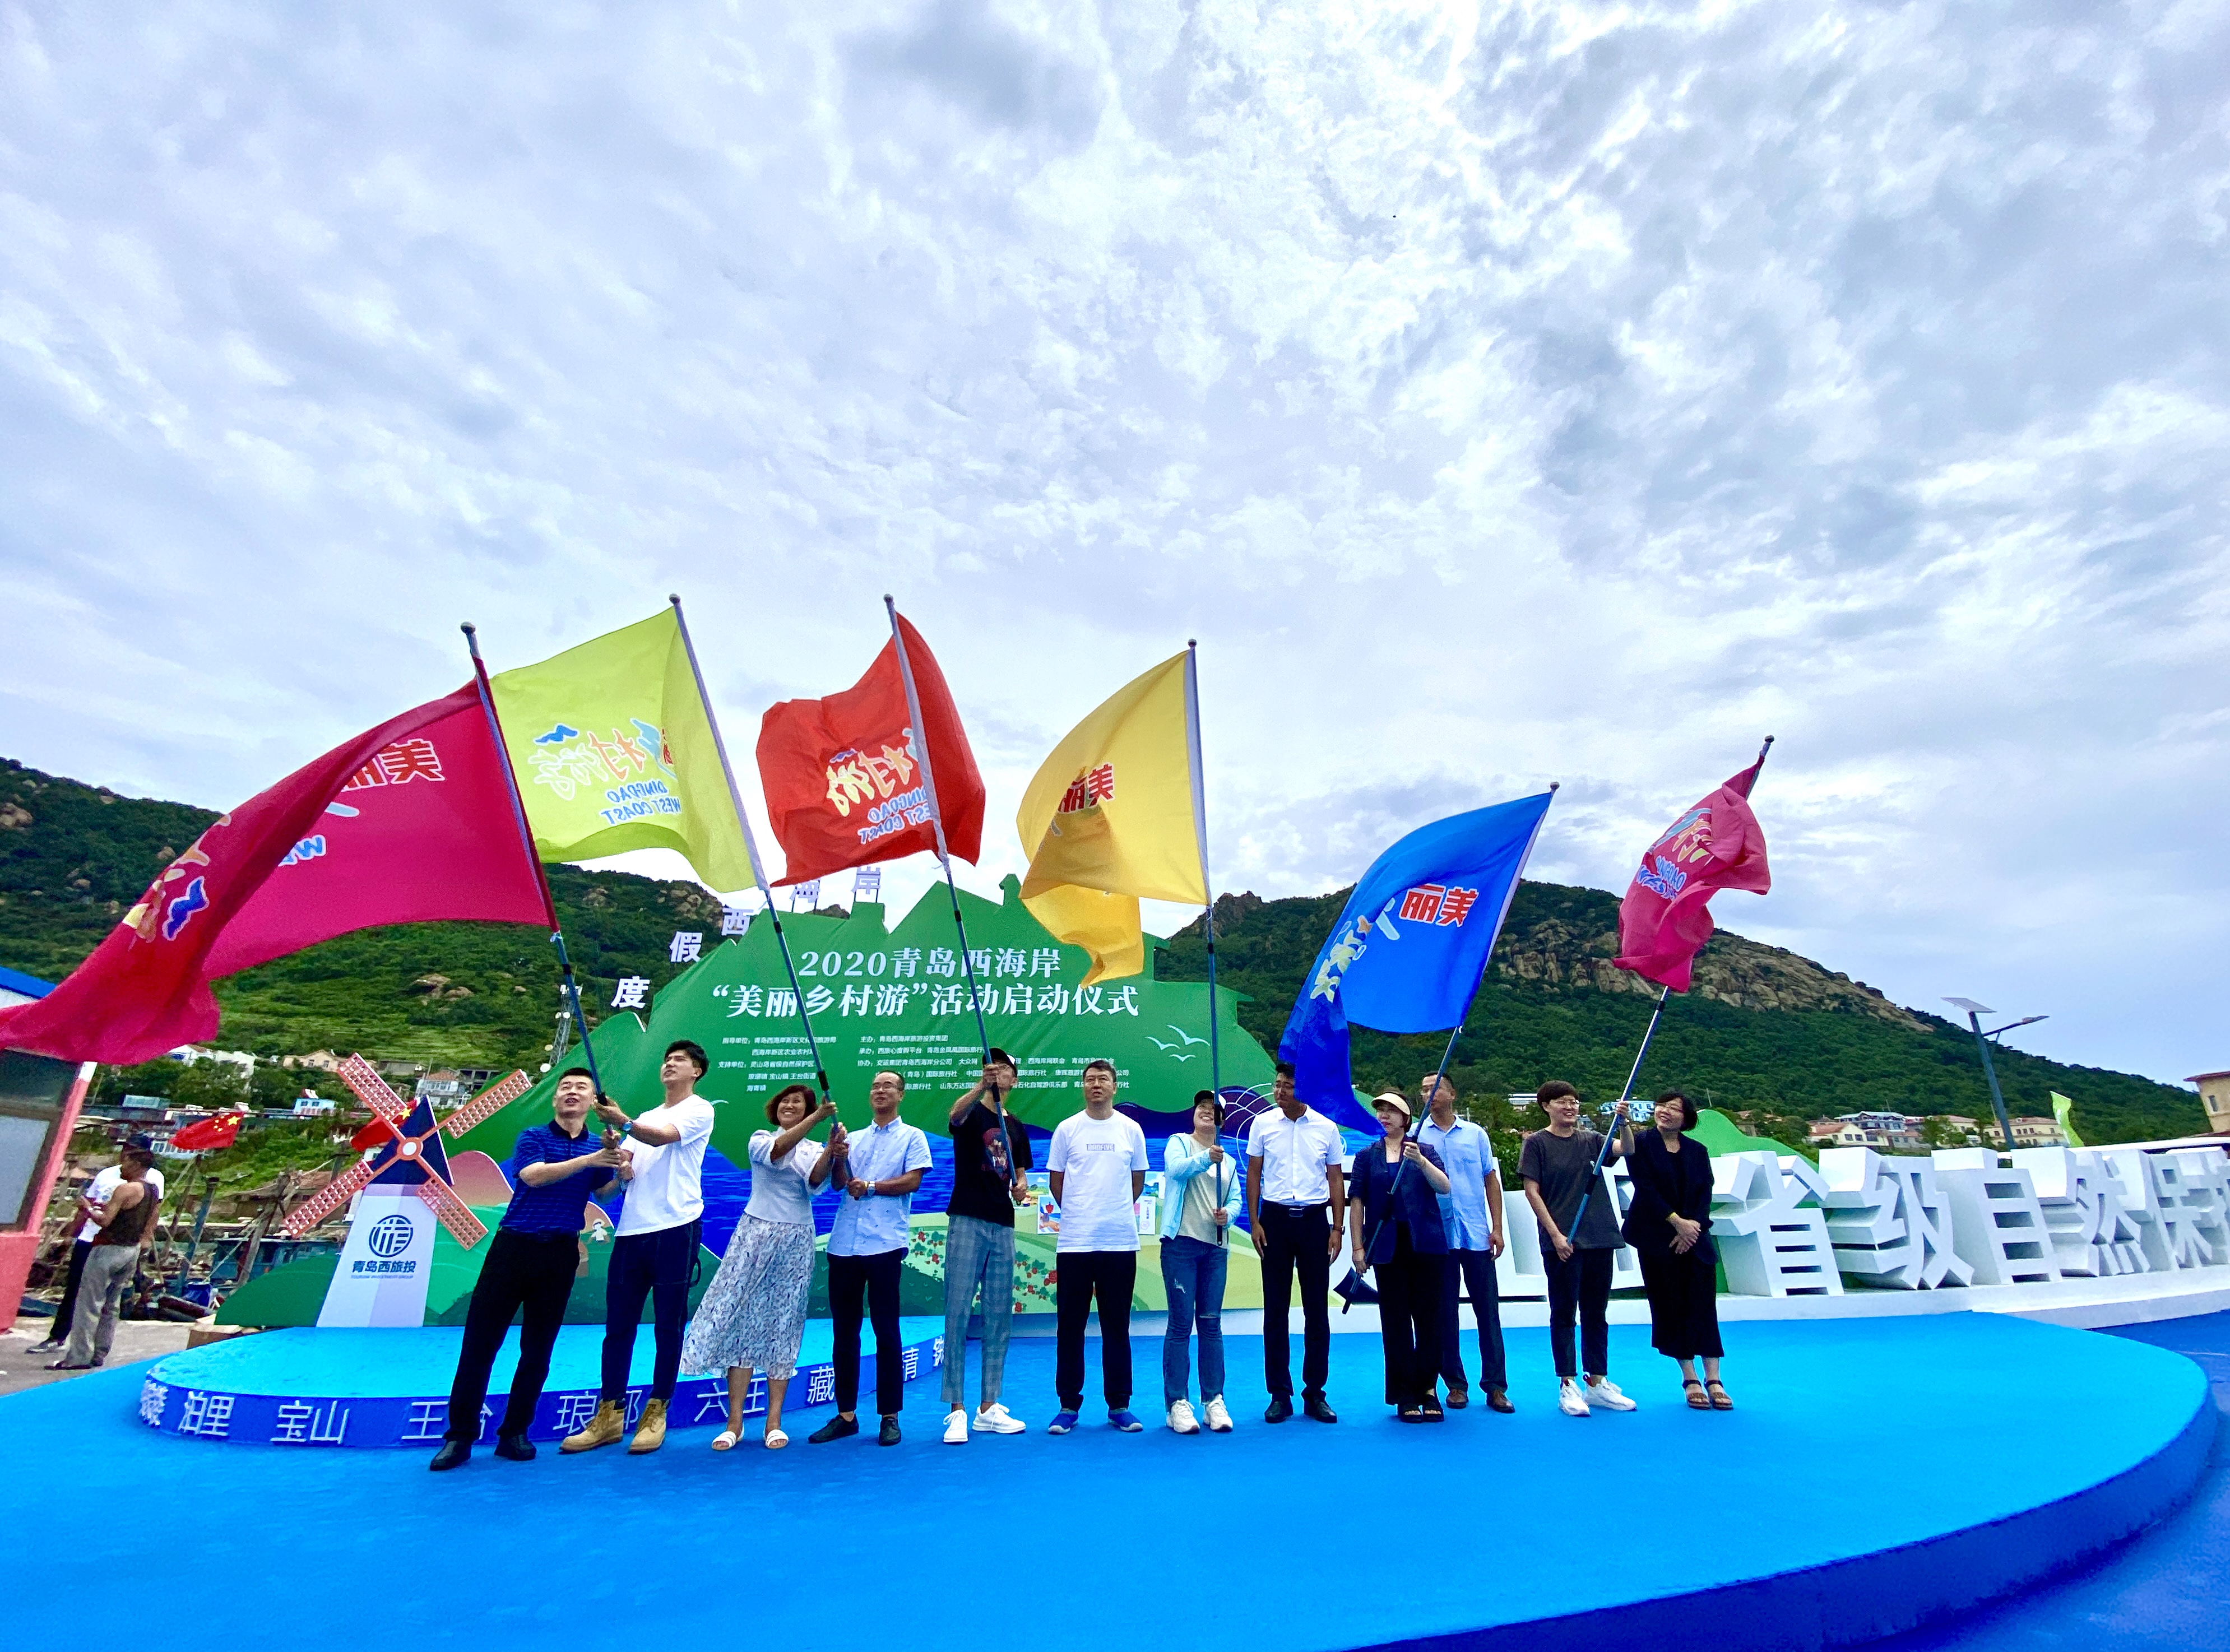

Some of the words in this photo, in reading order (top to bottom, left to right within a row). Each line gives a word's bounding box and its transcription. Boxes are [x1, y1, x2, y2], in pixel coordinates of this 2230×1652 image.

[799, 947, 1061, 978] 2020青岛西海岸
[353, 1260, 416, 1273] 青岛西旅投
[270, 1400, 350, 1444] 宝山
